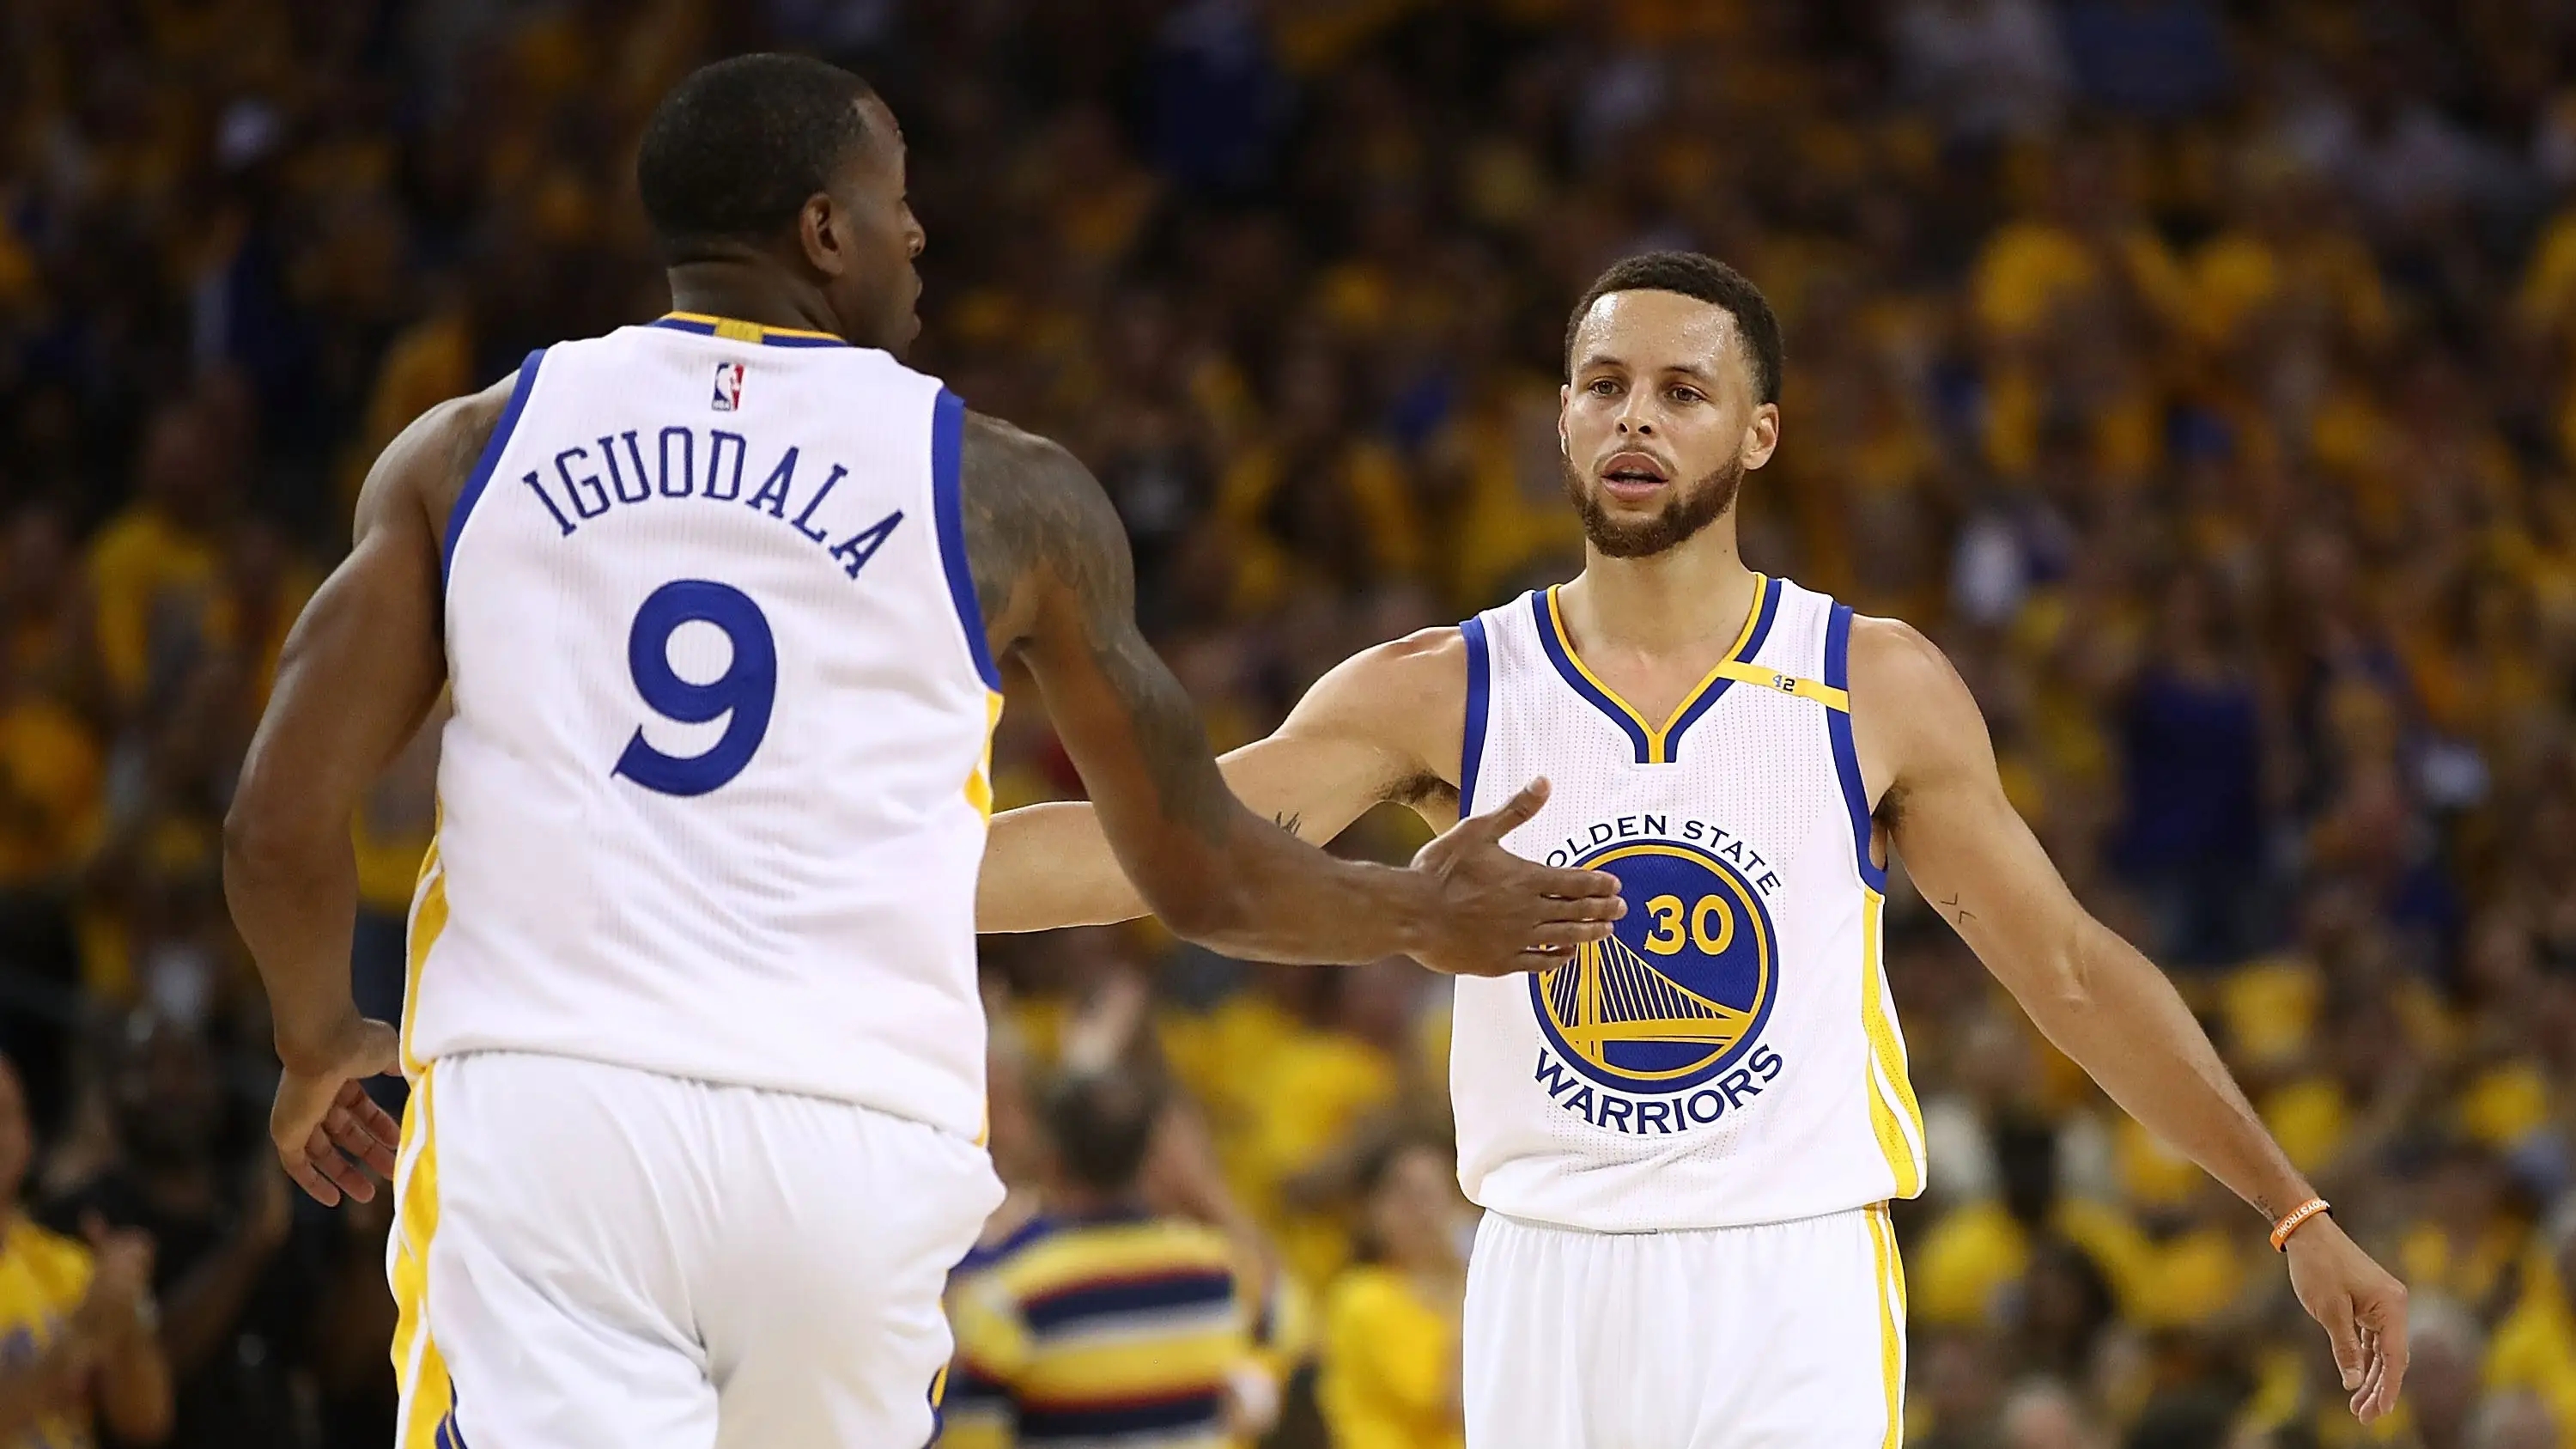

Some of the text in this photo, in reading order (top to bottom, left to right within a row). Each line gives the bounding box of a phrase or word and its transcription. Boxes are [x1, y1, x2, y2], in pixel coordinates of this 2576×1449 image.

[523, 427, 904, 580] IGUODALA
[611, 579, 777, 797] 9
[1772, 674, 1795, 692] 42
[1546, 814, 1781, 897] OLDEN STATE
[1644, 894, 1735, 956] 30
[1534, 1043, 1784, 1135] WARRIORS
